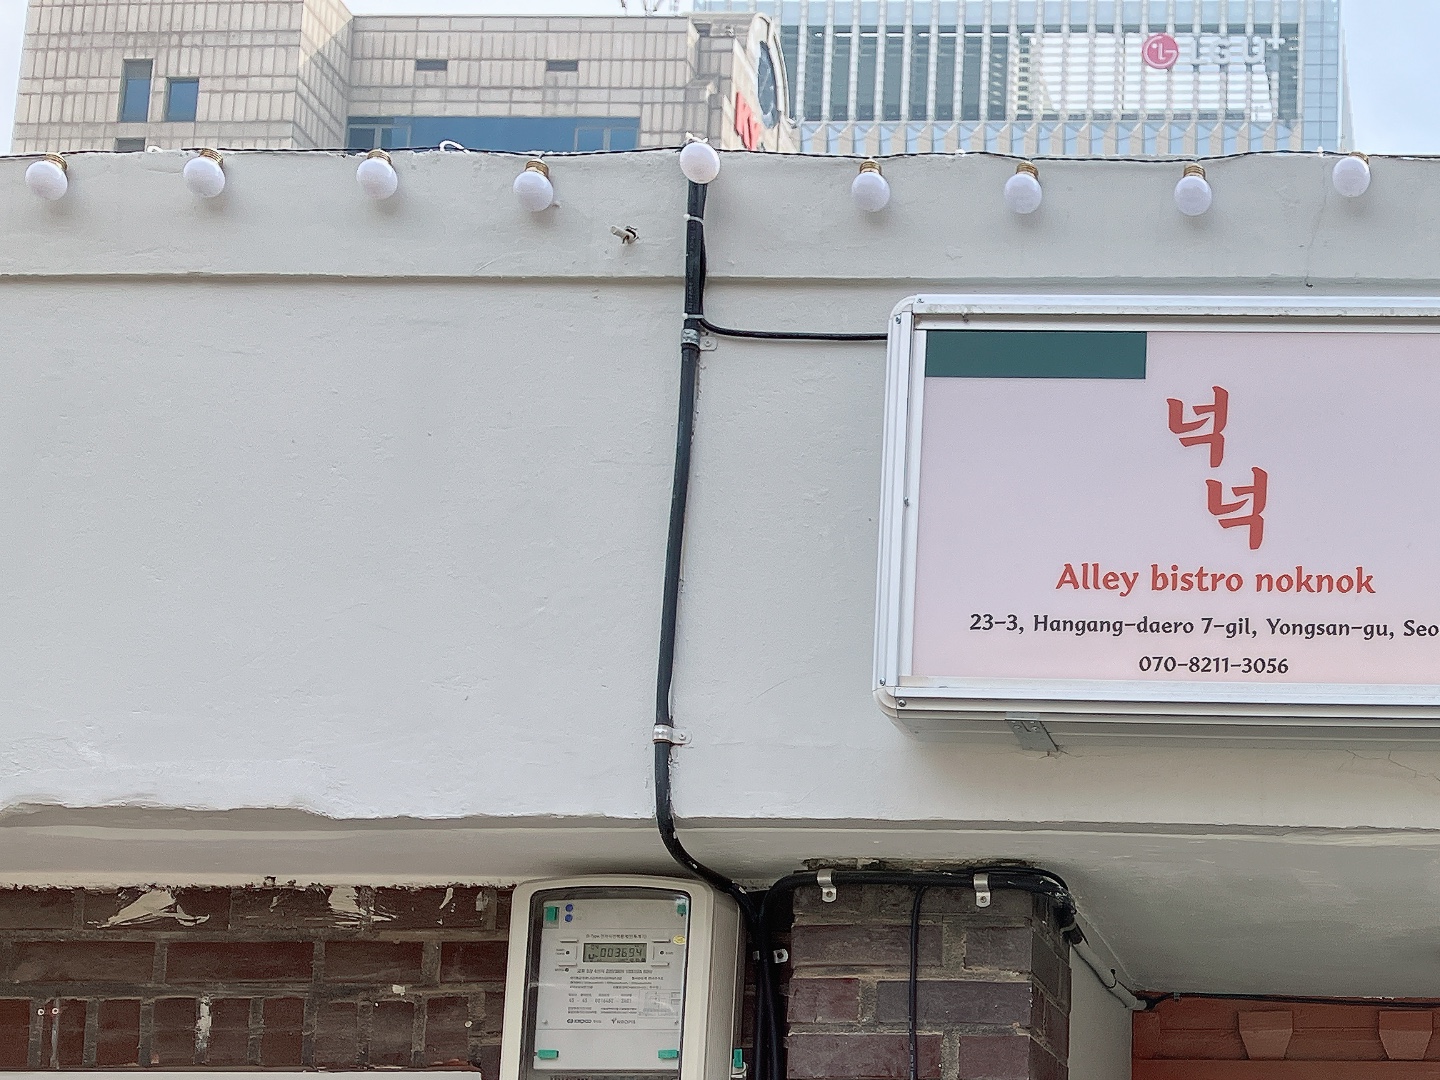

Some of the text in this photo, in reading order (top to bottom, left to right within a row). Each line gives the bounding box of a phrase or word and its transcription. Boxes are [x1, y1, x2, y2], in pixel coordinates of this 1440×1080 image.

[1056, 563, 1377, 597] Alley bistro noknok
[969, 613, 1025, 636] 23-3,
[1033, 614, 1195, 637] Hangang-daero
[1201, 617, 1258, 639] 7-gil,
[1265, 617, 1395, 641] Yongsan-gu,
[1138, 655, 1289, 675] 070-8211-3056
